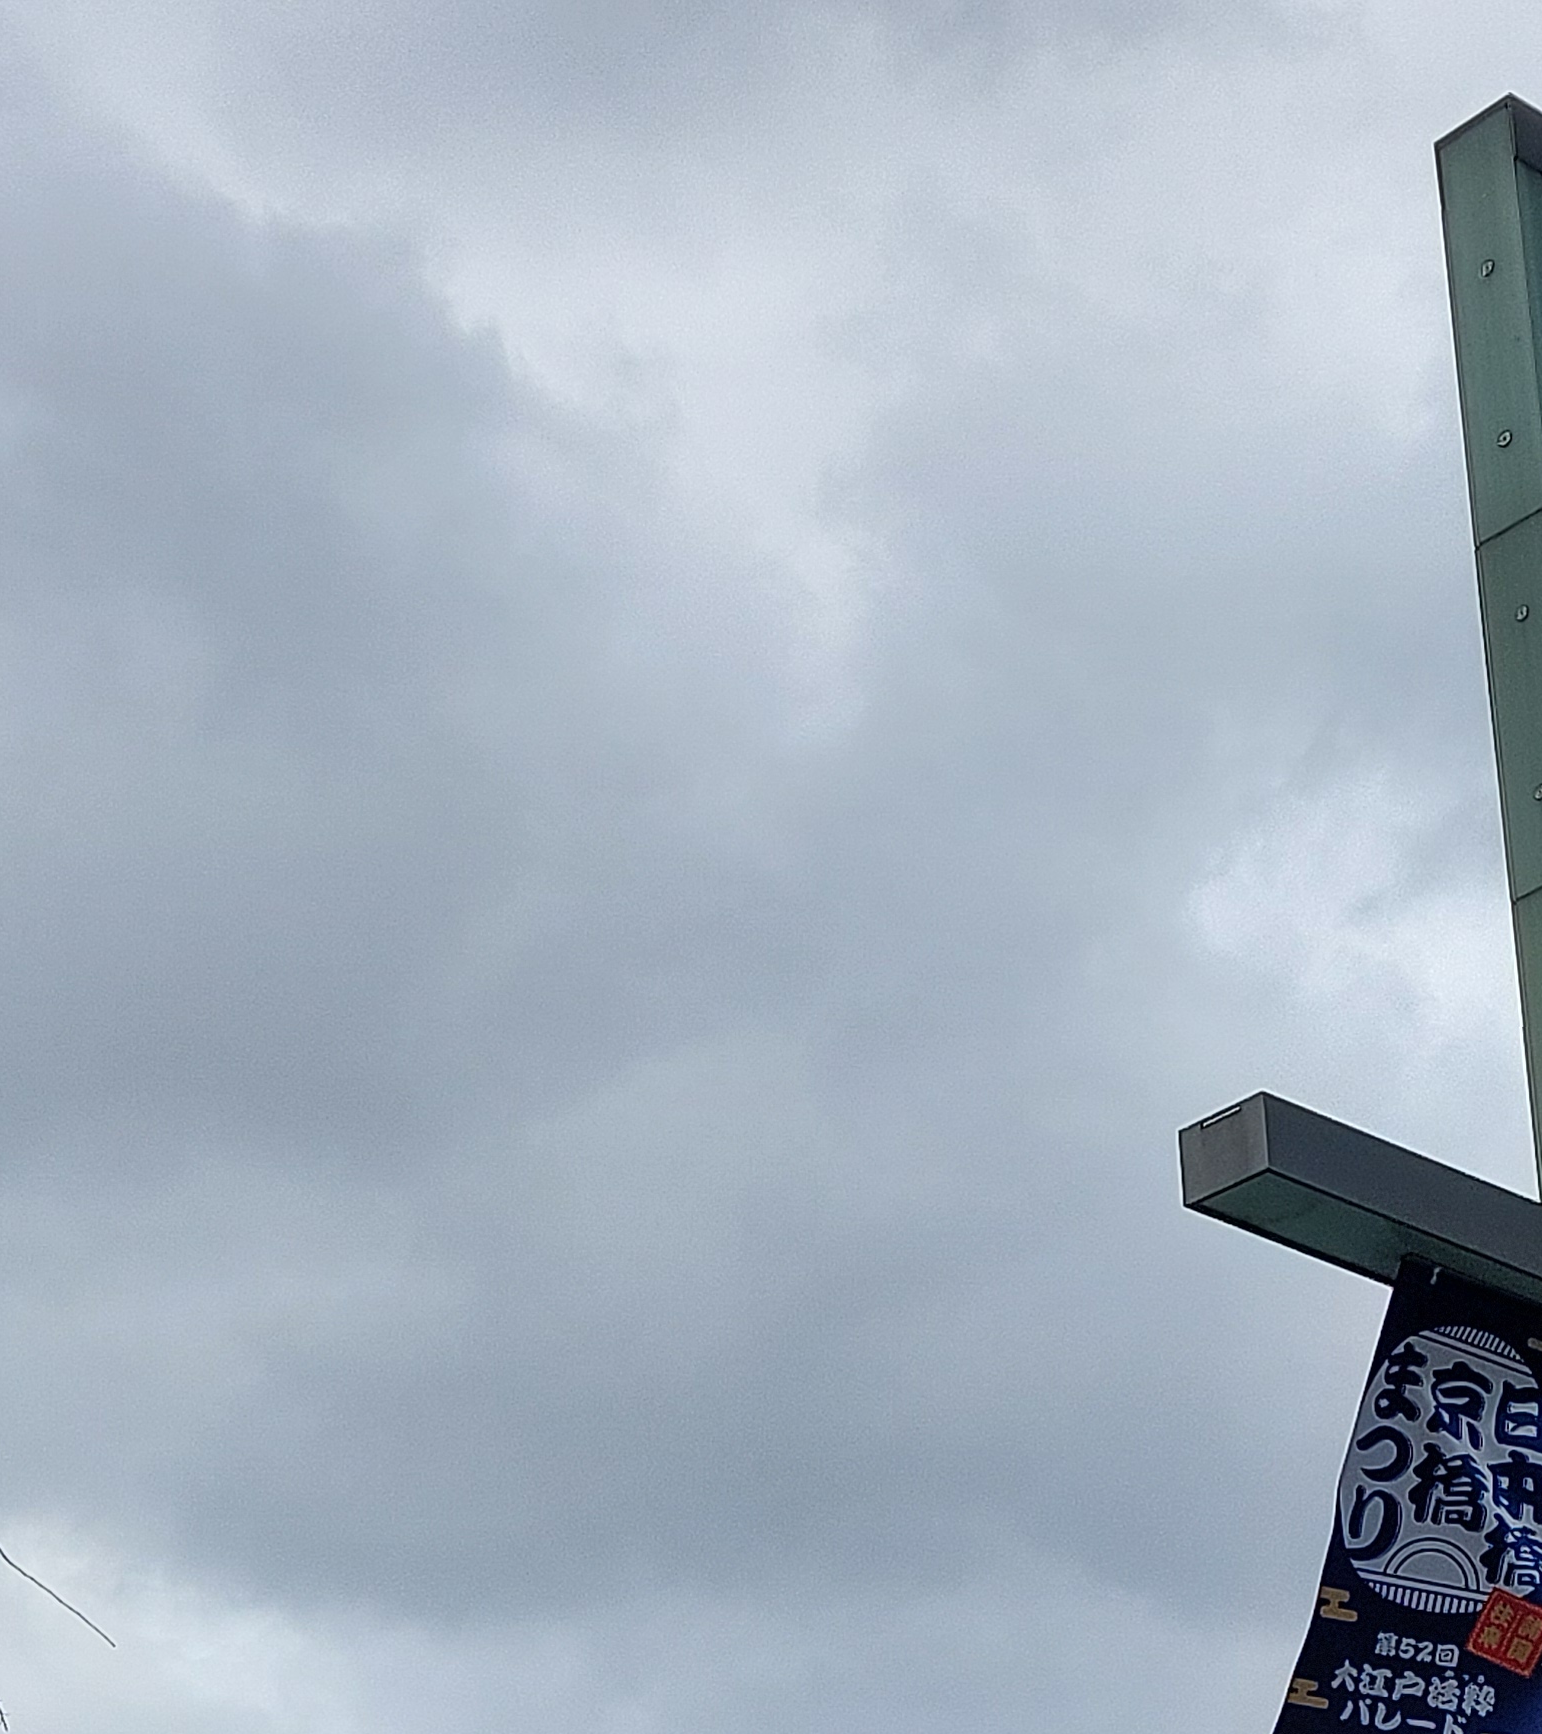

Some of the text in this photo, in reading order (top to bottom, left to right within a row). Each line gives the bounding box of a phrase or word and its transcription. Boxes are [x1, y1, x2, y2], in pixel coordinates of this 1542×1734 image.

[1347, 1341, 1429, 1561] まつり
[1408, 1360, 1494, 1533] 京橋
[1374, 1632, 1460, 1668] 第52回
